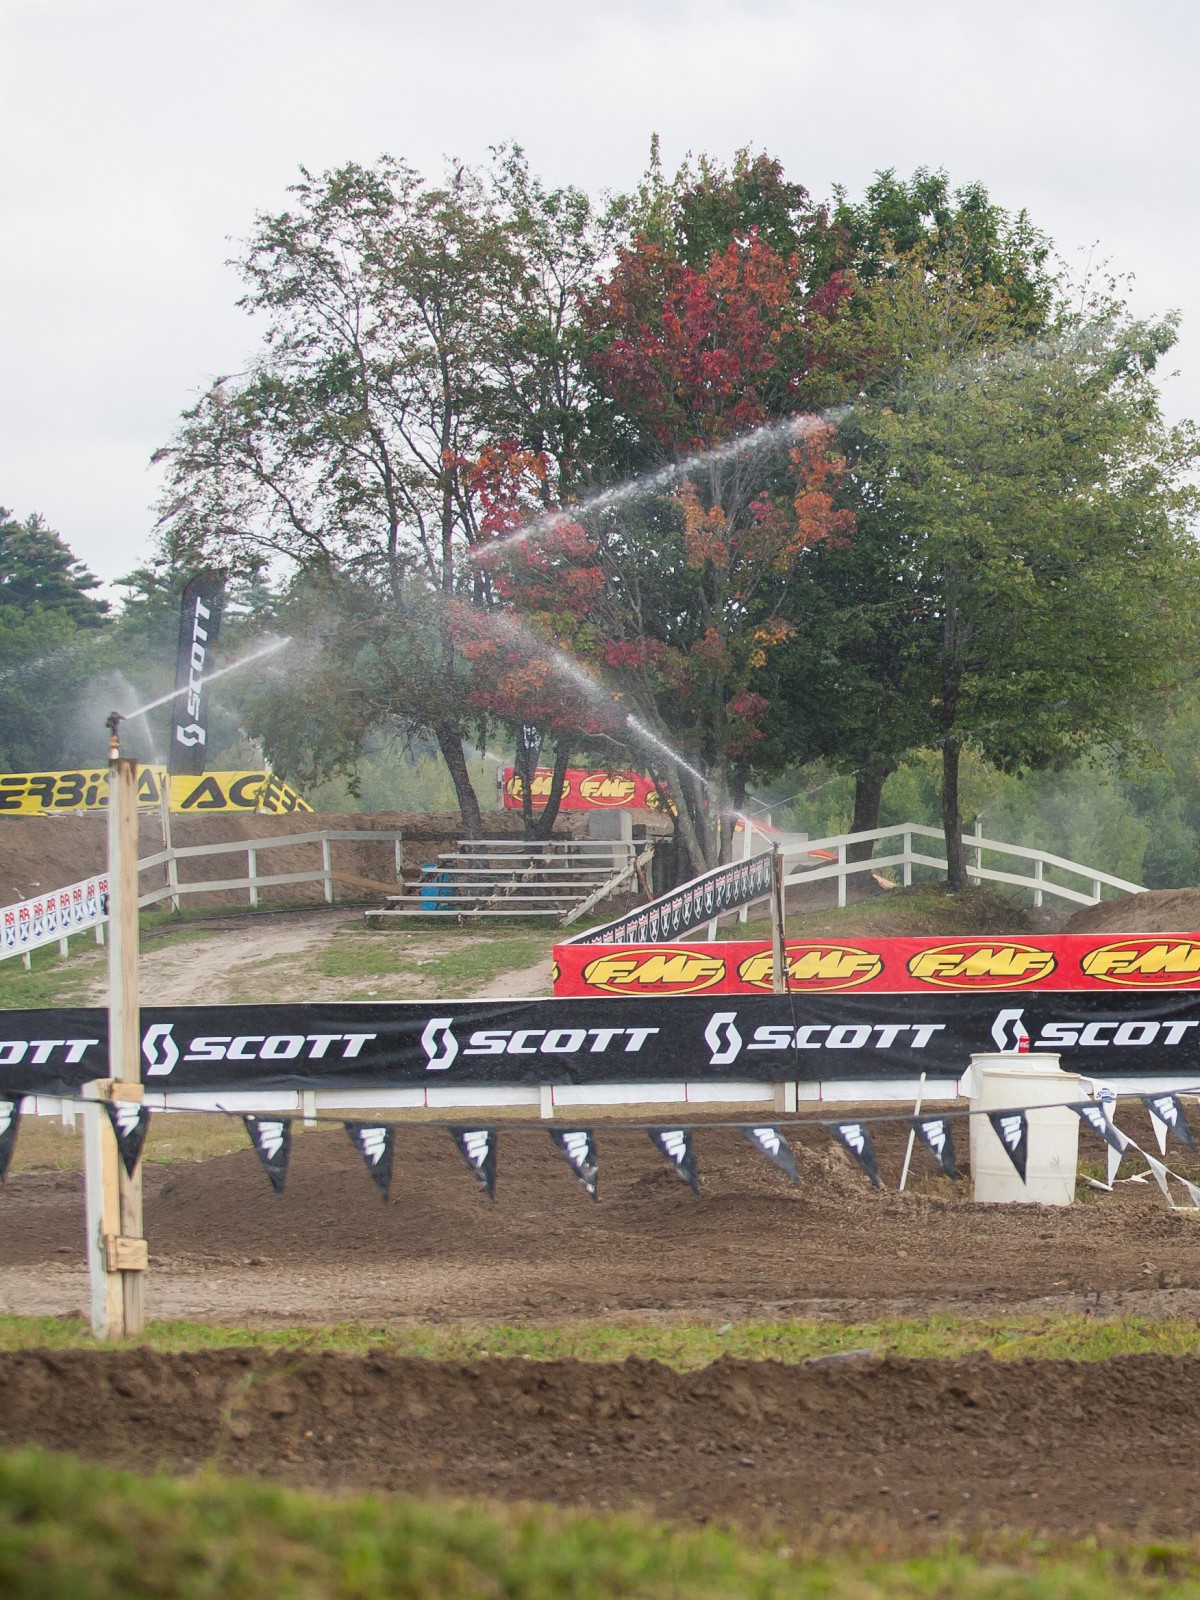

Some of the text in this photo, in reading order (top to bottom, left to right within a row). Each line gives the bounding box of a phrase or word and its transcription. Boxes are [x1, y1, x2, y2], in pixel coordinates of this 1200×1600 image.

[187, 596, 211, 722] SCOTT
[581, 778, 636, 798] FMF
[587, 955, 724, 984] FMF
[741, 951, 881, 981] FMF
[910, 948, 1054, 977] FMF
[183, 1033, 378, 1061] SCOTT
[463, 1027, 660, 1055] SCOTT
[746, 1023, 946, 1050] SCOTT
